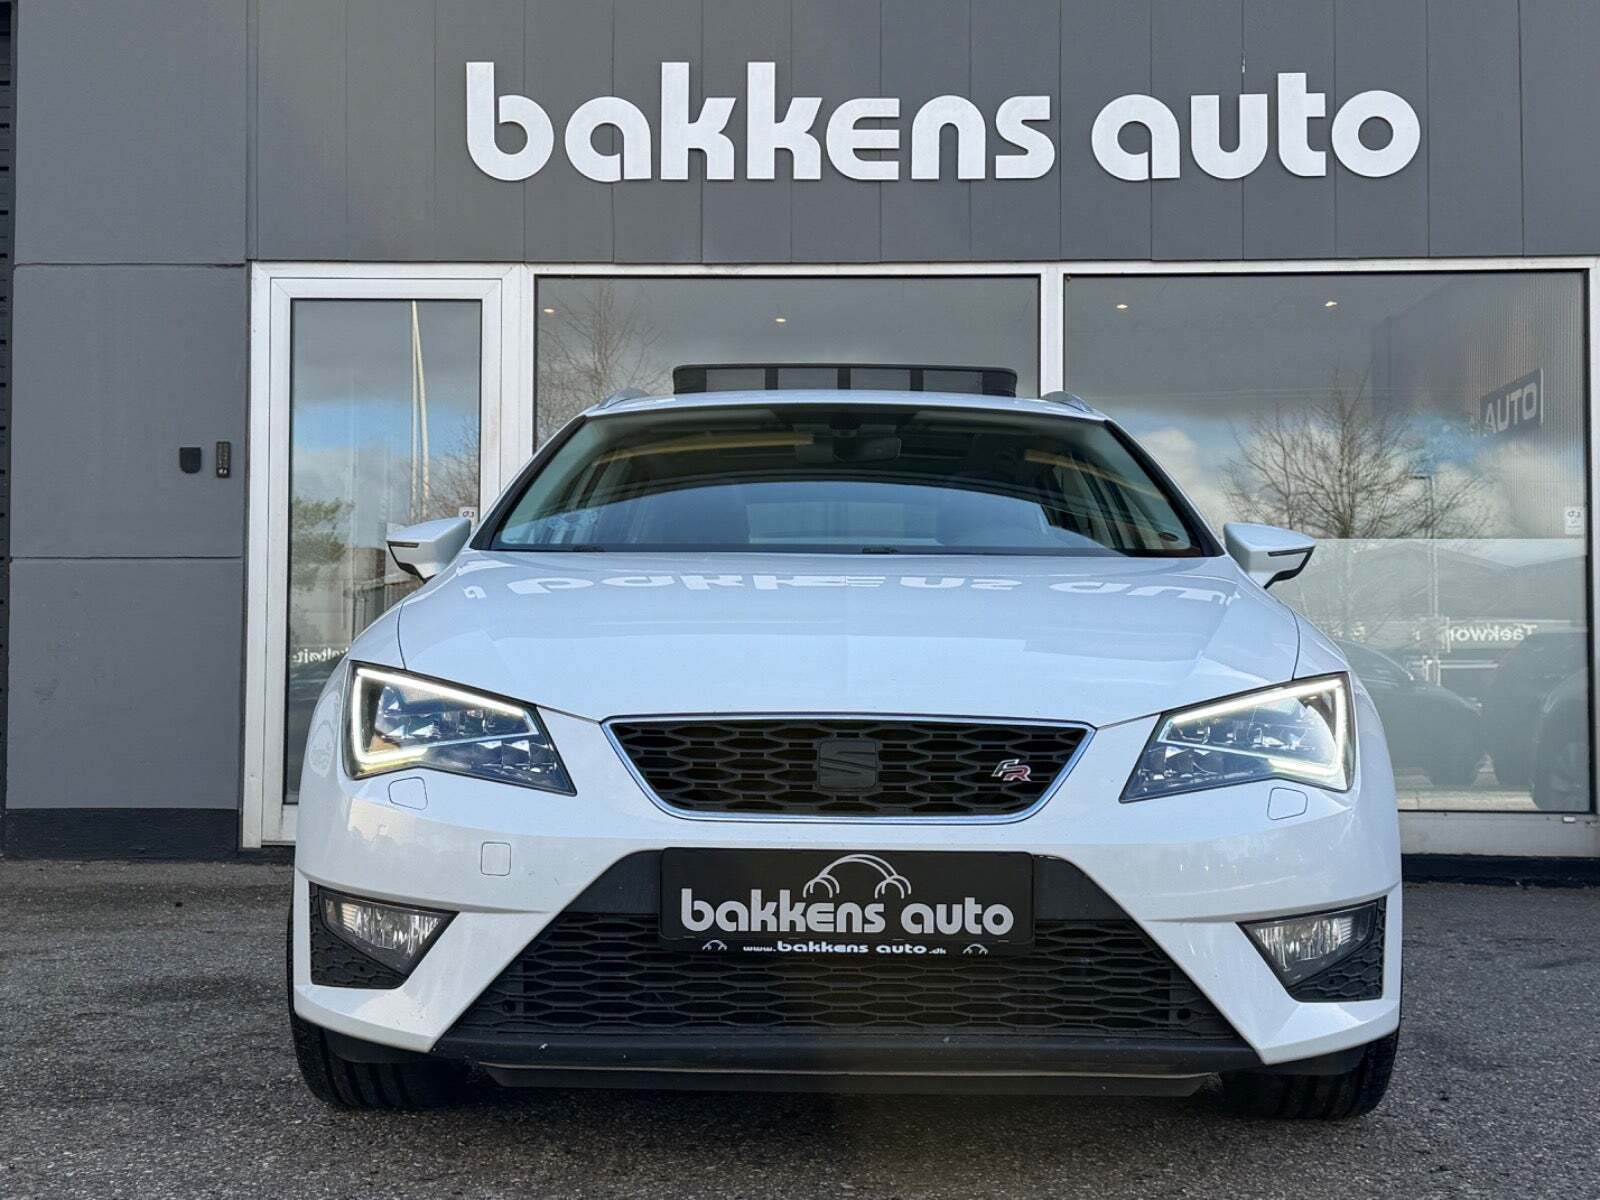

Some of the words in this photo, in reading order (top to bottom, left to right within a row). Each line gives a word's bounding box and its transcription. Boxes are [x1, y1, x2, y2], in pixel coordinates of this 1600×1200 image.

[466, 61, 1056, 183] bakkens
[1091, 72, 1421, 181] auto
[1485, 382, 1538, 434] AUTO
[990, 758, 1032, 782] FR
[681, 888, 886, 933] bakkens
[901, 897, 1014, 935] auto
